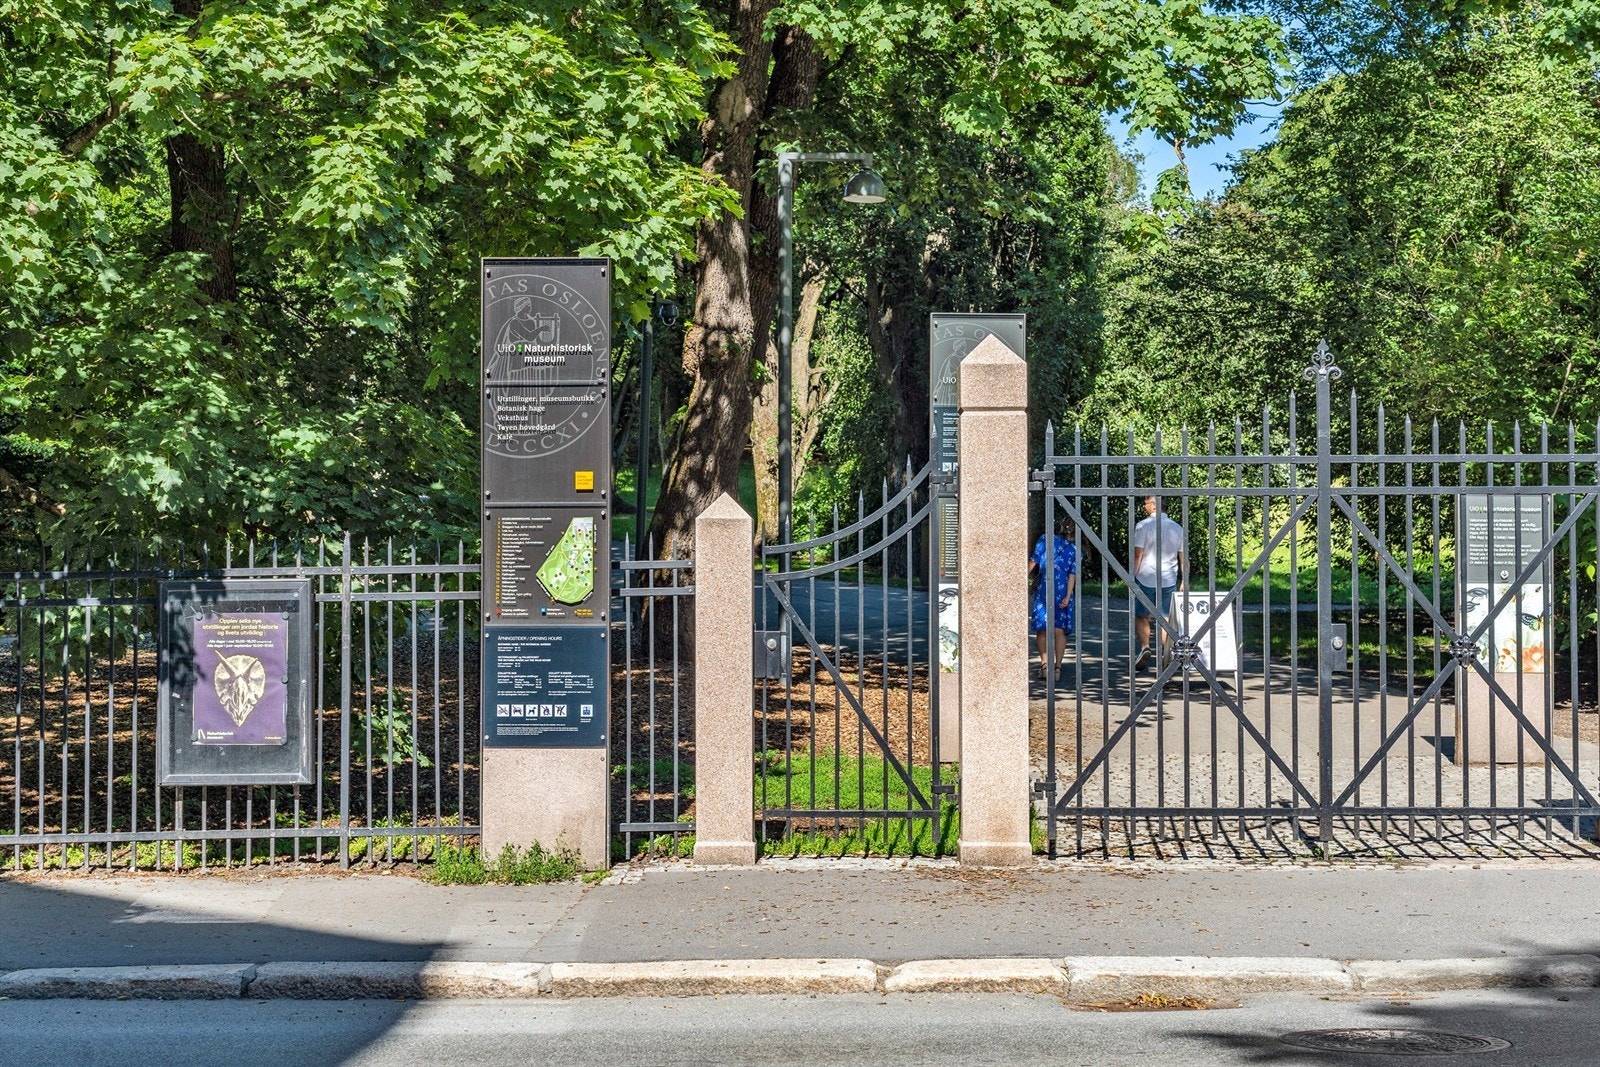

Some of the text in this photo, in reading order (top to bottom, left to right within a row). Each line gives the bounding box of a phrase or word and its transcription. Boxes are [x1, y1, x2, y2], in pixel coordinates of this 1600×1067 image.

[497, 344, 593, 353] UiO Naturhistorisk
[524, 355, 565, 363] museum
[942, 376, 957, 384] UiO
[528, 405, 546, 413] hage
[519, 424, 556, 432] hovedgård
